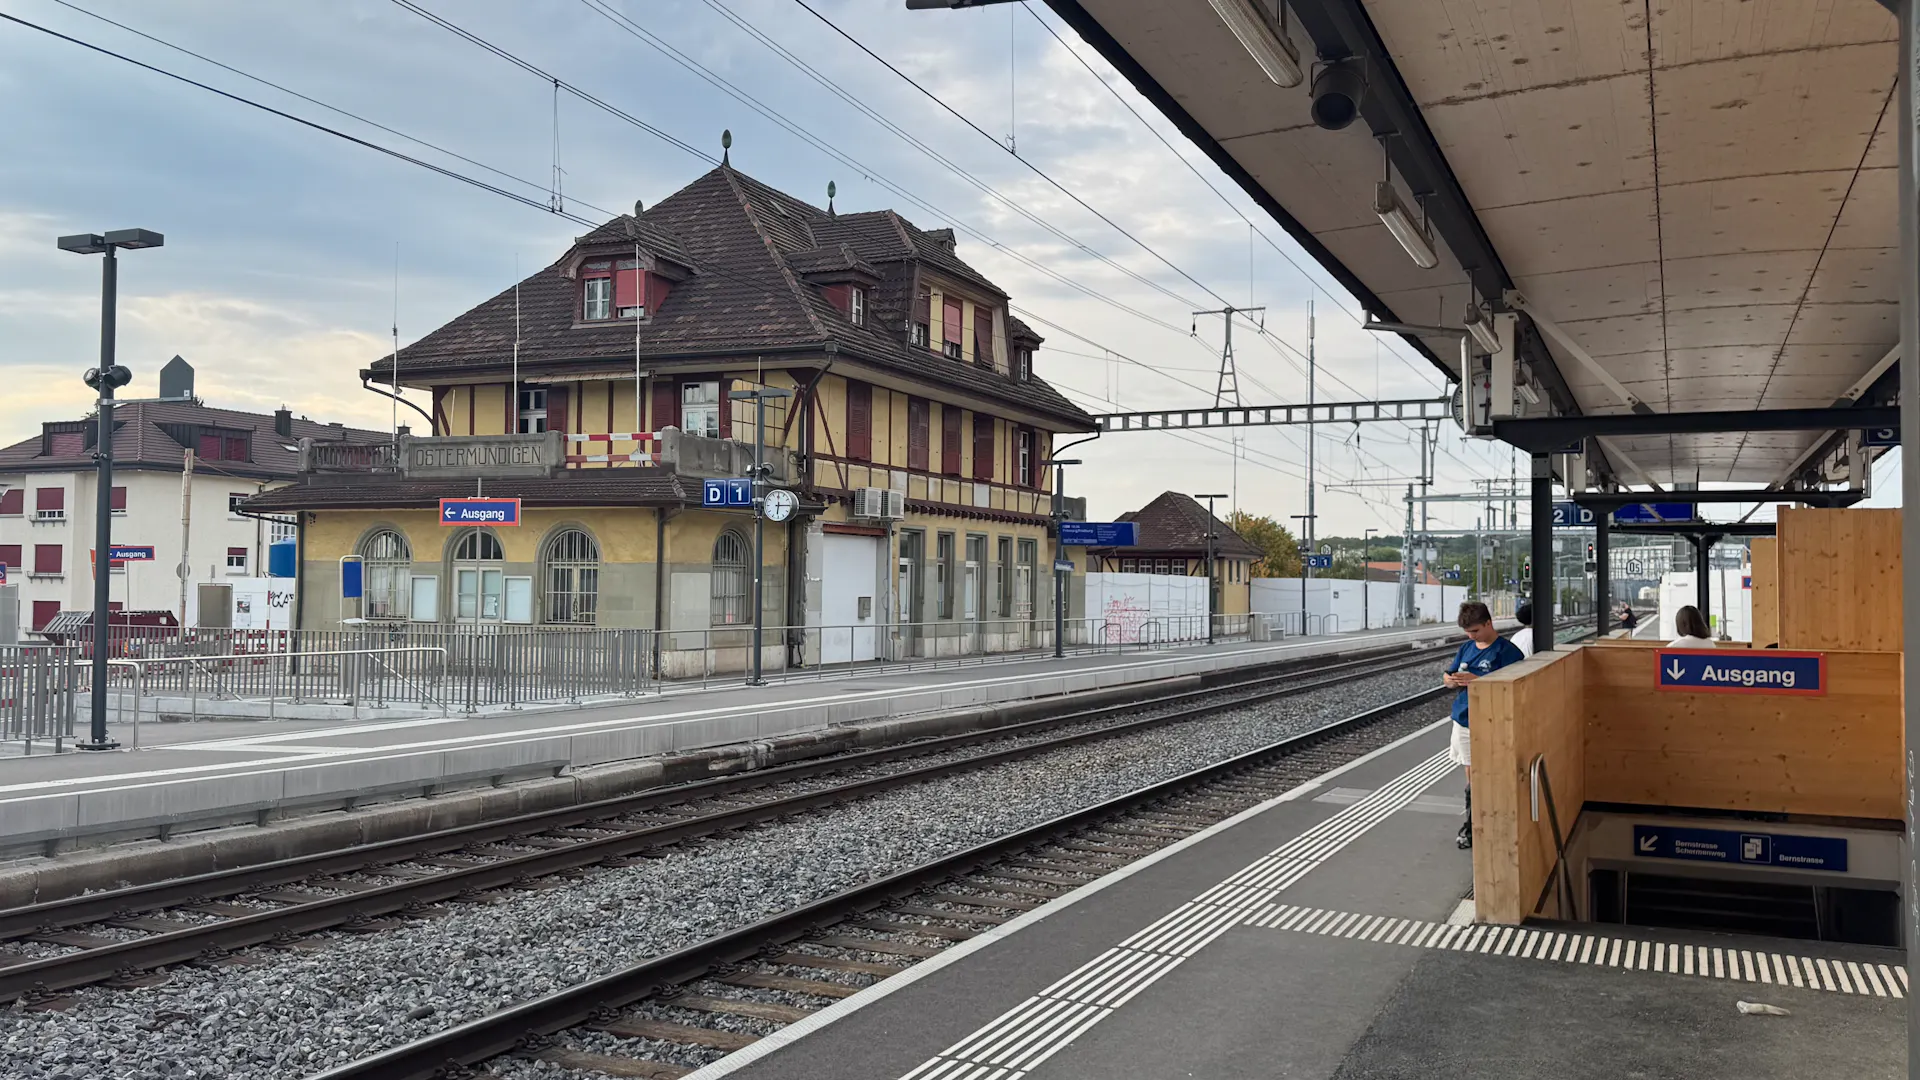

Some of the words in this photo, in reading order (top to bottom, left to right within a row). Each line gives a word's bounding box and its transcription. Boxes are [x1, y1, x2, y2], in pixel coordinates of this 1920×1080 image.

[415, 446, 541, 467] OSTERMUNDIGEN
[709, 487, 721, 502] D
[735, 486, 742, 502] 1
[461, 508, 505, 521] Ausgang
[1553, 509, 1564, 523] 2
[1580, 509, 1593, 522] D
[1309, 558, 1316, 566] C
[1323, 558, 1328, 566] 1
[1701, 665, 1796, 687] Ausgang
[1675, 840, 1718, 849] Bernstrasse
[1675, 847, 1726, 858] Schermenweg
[1779, 854, 1824, 864] Bernstrasse
